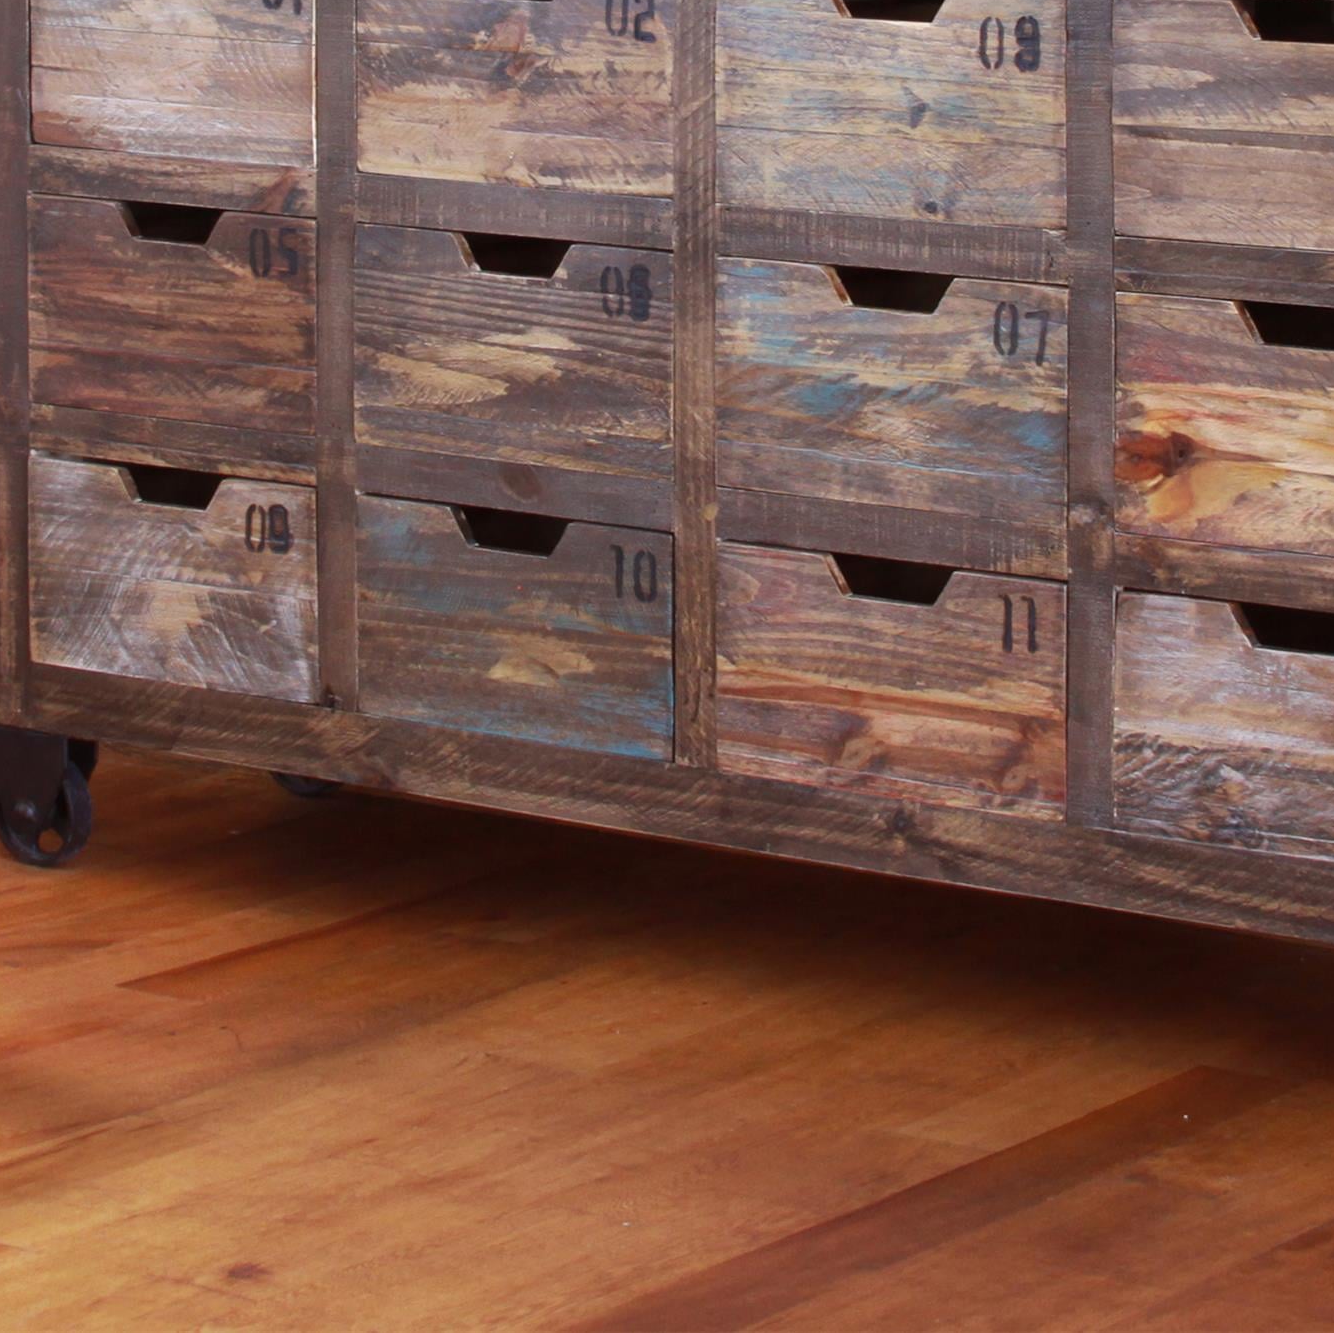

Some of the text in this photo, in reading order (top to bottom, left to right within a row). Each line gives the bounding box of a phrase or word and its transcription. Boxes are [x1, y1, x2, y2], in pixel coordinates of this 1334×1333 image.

[248, 226, 300, 277] 05
[992, 300, 1050, 367] 07
[609, 544, 658, 604] 10
[998, 593, 1039, 654] 11
